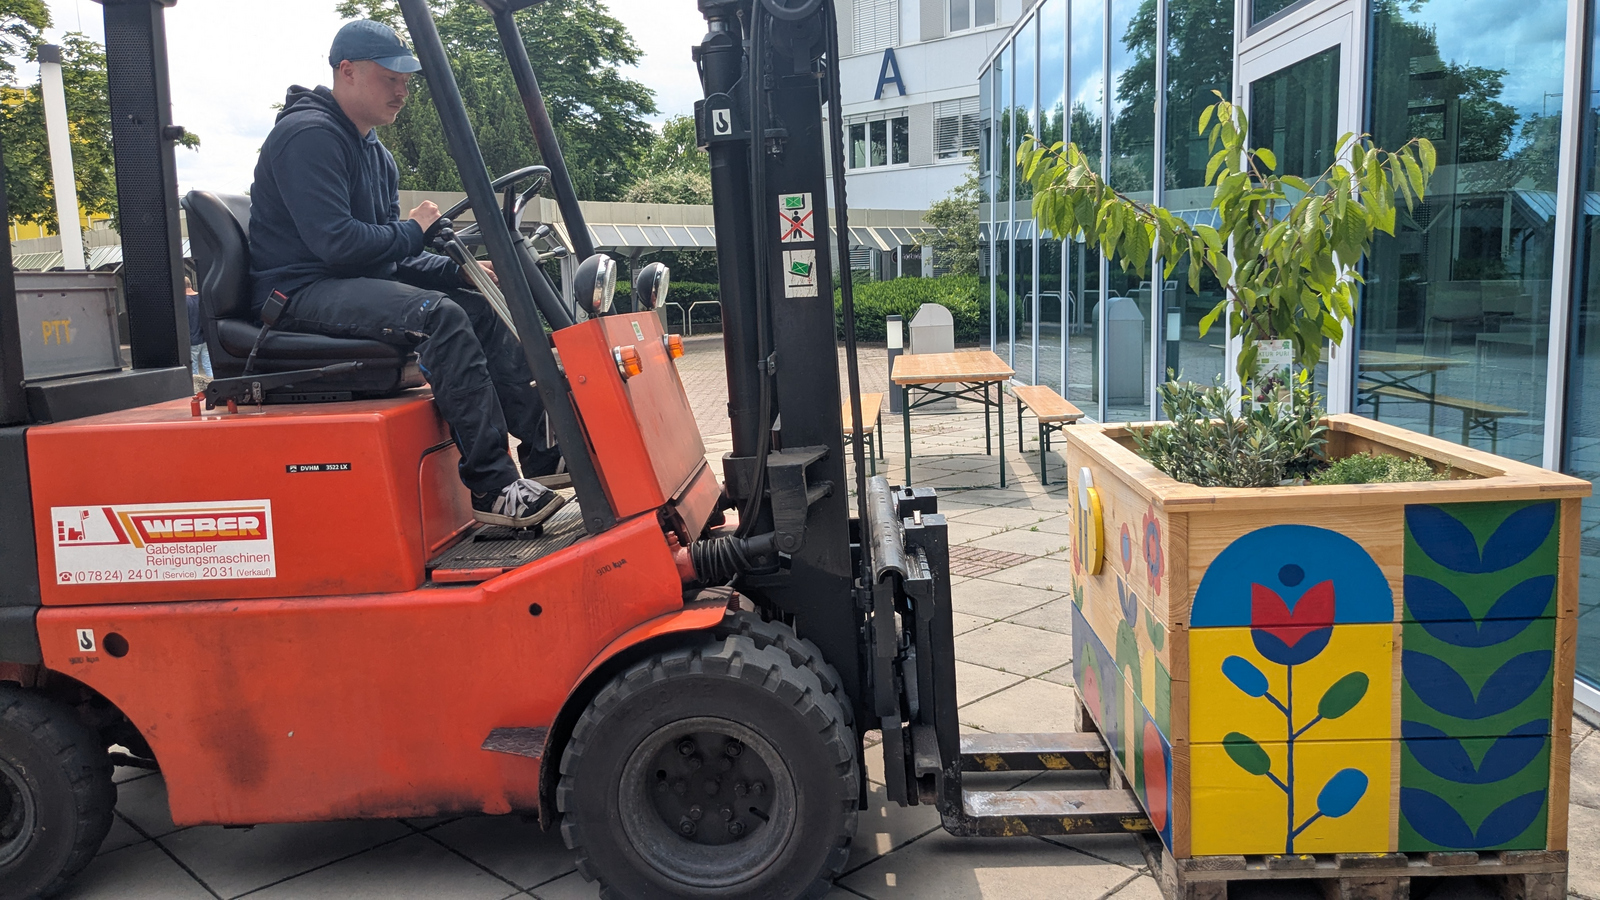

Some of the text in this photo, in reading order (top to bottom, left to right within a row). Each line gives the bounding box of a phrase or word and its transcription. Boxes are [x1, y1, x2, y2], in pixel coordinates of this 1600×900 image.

[874, 48, 906, 100] A
[42, 320, 71, 345] PTT
[141, 516, 261, 539] WEBER
[145, 543, 218, 555] Gabelstapler
[146, 553, 271, 567] Reinigungsmaschinen
[162, 571, 197, 579] (Service)
[236, 568, 271, 578] (Verkauf)
